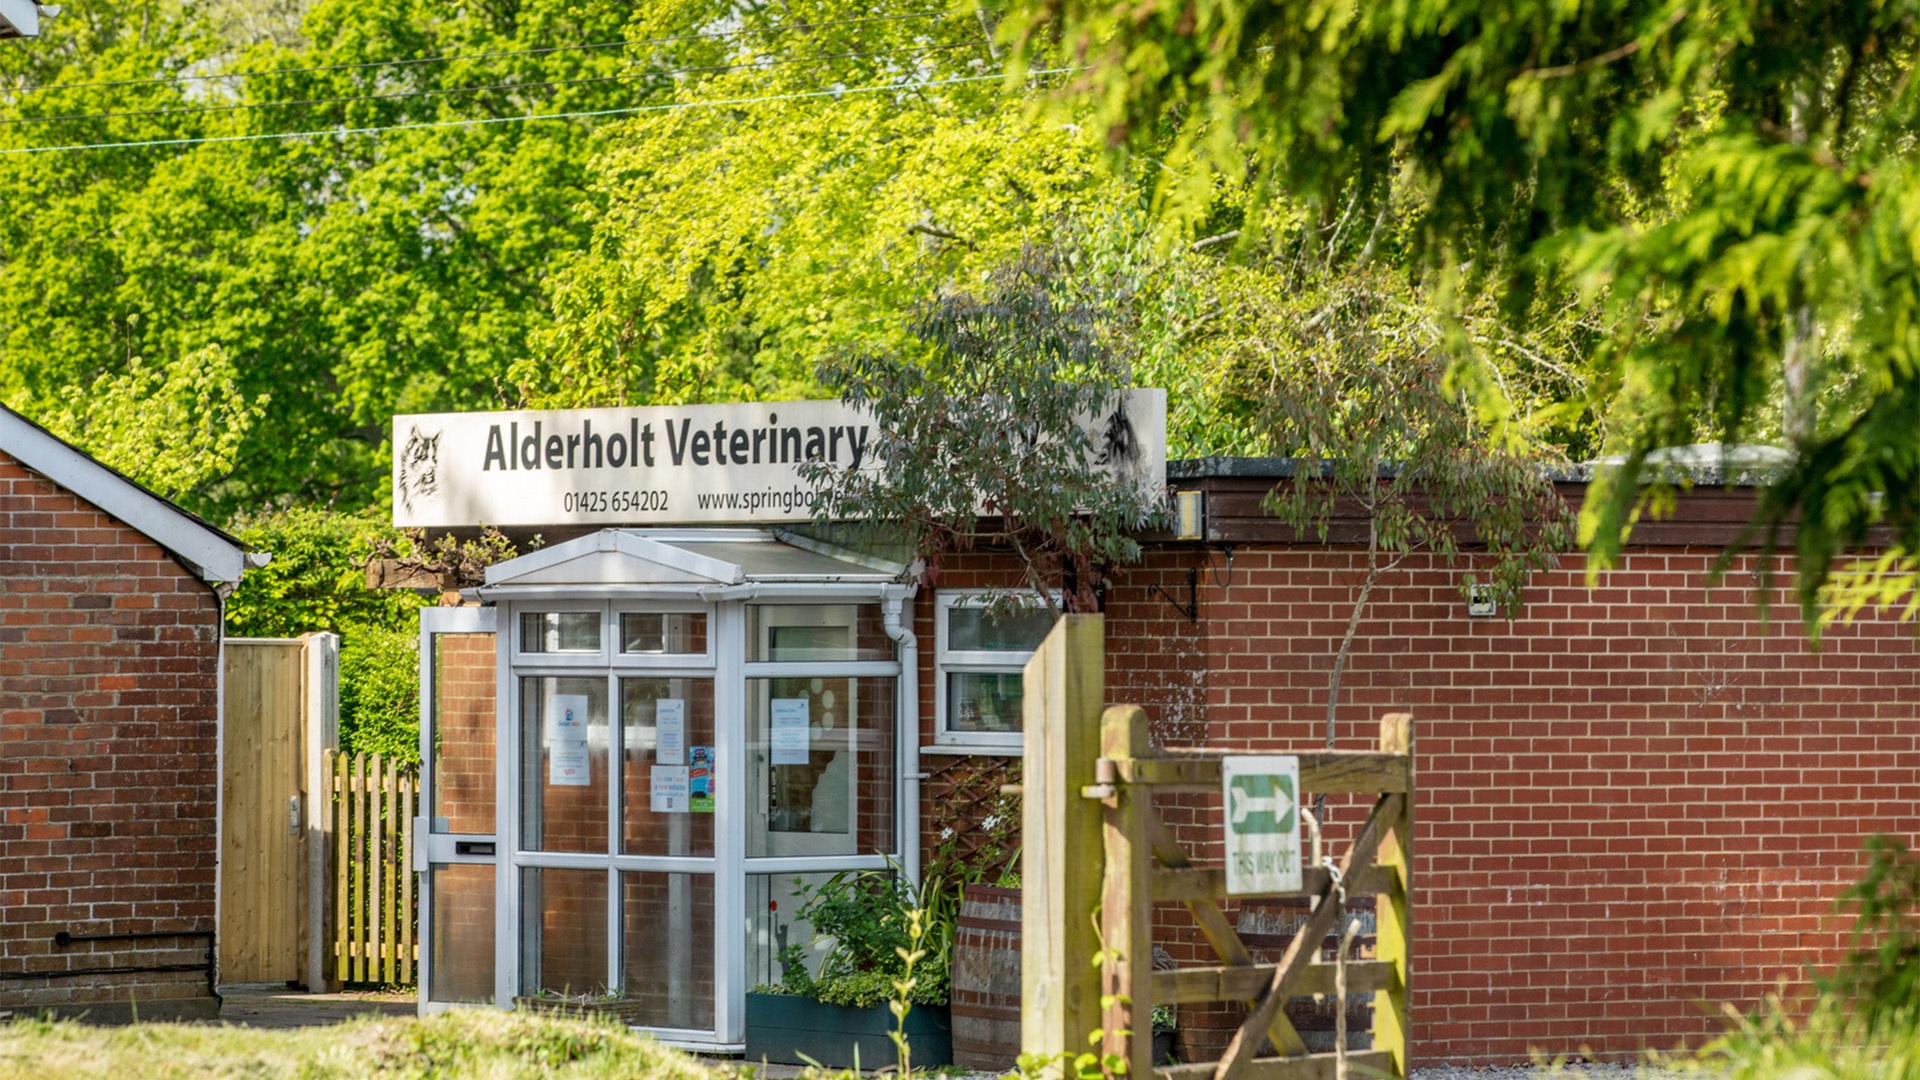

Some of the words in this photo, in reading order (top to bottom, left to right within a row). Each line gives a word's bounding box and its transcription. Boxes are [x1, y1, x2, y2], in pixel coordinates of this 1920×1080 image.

[483, 417, 655, 471] Alderholt
[665, 412, 869, 470] Veterinary
[564, 492, 607, 512] 01425
[611, 490, 668, 511] 654202
[1232, 852, 1254, 875] THIS
[1255, 851, 1275, 874] WAY
[1277, 850, 1296, 873] OUT
